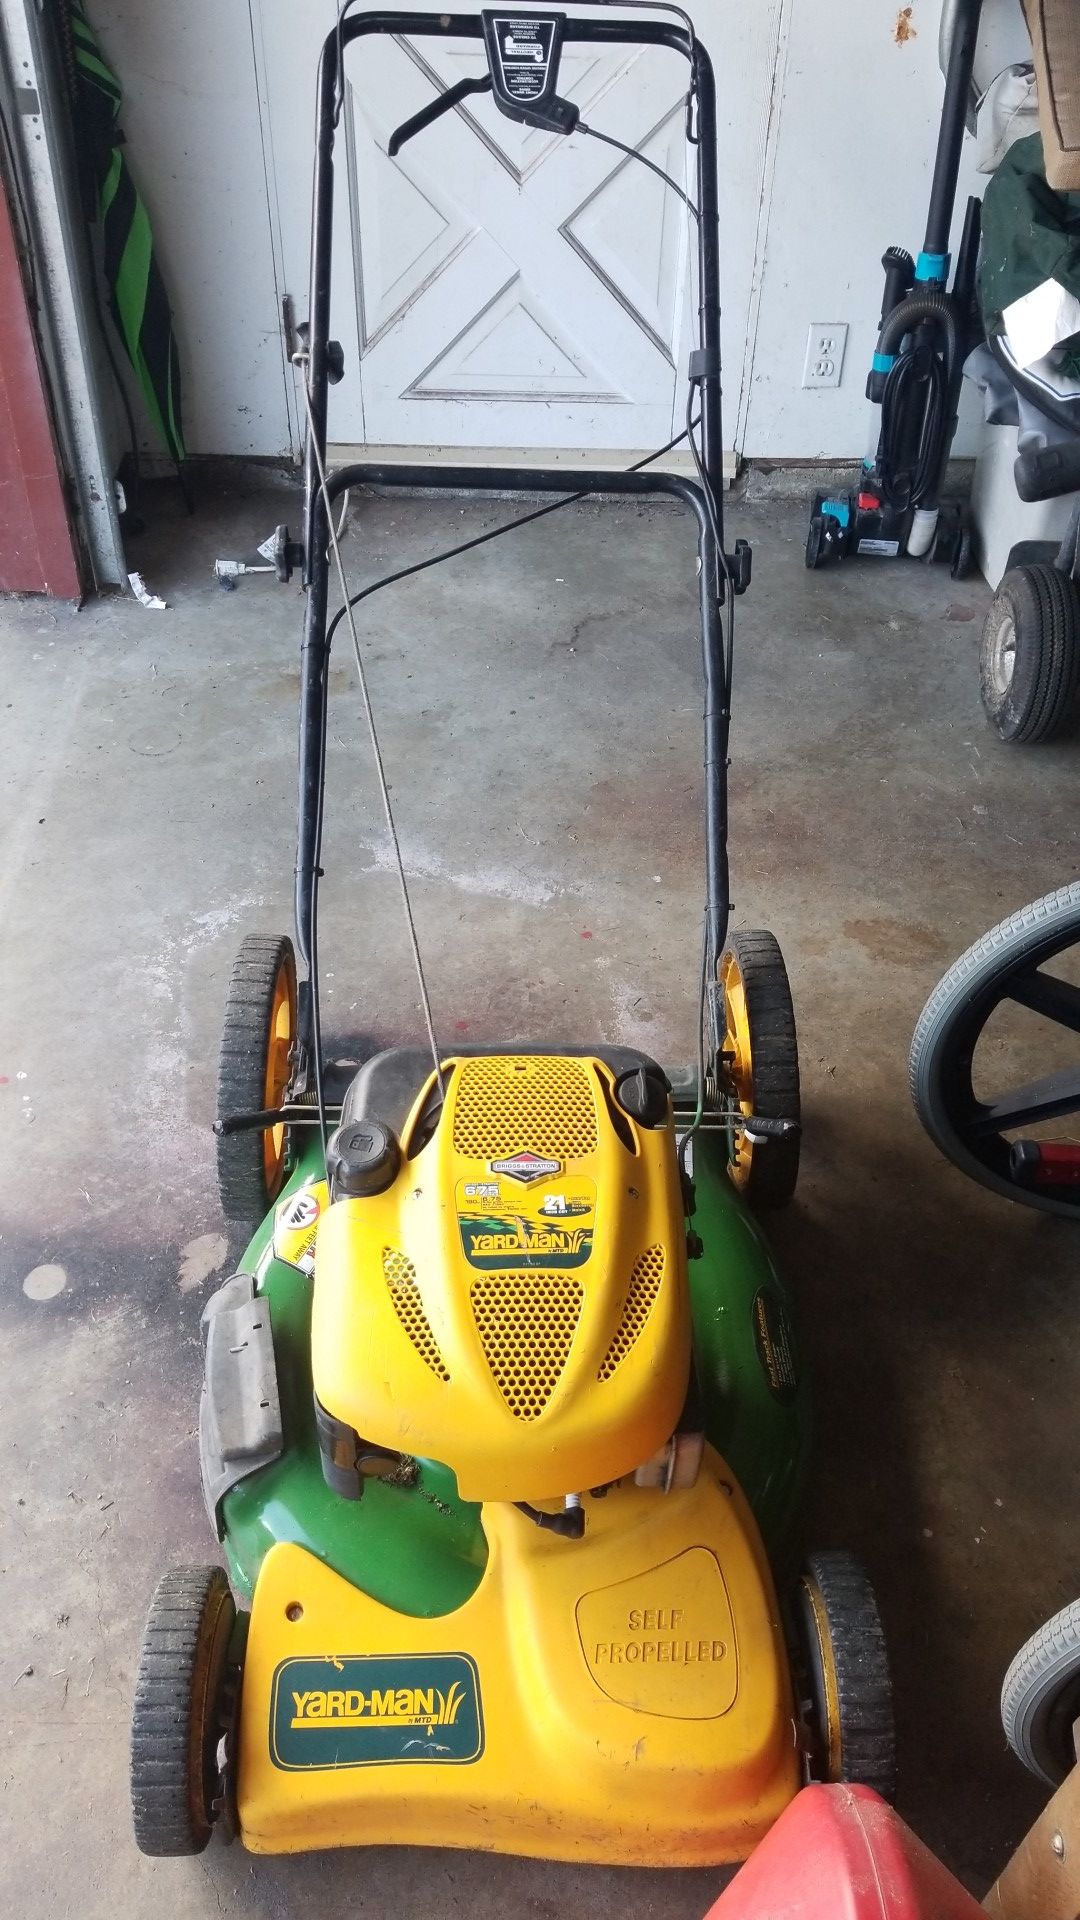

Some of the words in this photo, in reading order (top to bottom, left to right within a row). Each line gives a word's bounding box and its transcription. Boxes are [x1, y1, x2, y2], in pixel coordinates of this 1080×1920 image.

[464, 1185, 499, 1196] 675
[544, 1194, 566, 1210] 21
[628, 1609, 685, 1631] SELF
[594, 1640, 727, 1664] PROPELLED
